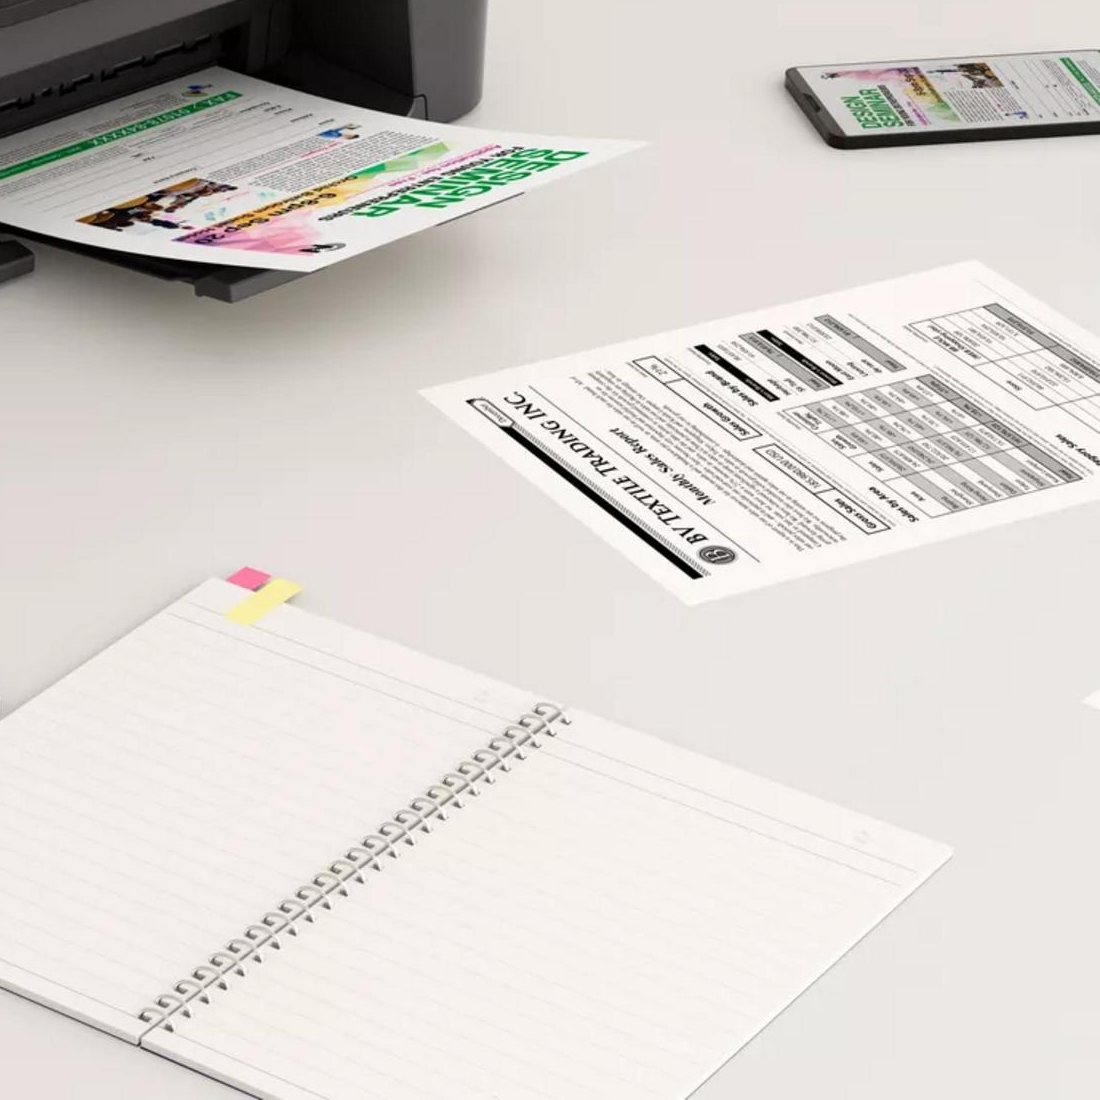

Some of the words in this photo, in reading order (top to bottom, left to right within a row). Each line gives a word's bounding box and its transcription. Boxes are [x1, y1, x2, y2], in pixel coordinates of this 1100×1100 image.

[841, 96, 882, 129] DESIGN
[350, 147, 553, 218] SEMINAR
[413, 148, 590, 209] DESIGN
[705, 370, 731, 387] Brand
[728, 385, 741, 394] by
[503, 391, 547, 420] INC.
[735, 392, 759, 407] Sales
[703, 402, 731, 423] Growth
[729, 421, 750, 436] Sales
[540, 420, 618, 477] TRADING
[609, 427, 648, 454] Report
[1055, 433, 1078, 449] Sales
[645, 453, 674, 474] Sales
[672, 473, 715, 506] Monthly
[868, 486, 889, 500] Area
[612, 475, 681, 526] TEXTILE
[834, 498, 857, 514] Sales
[886, 499, 900, 509] by
[854, 512, 877, 529] Gross
[897, 506, 920, 523] Sales
[671, 527, 709, 545] BV
